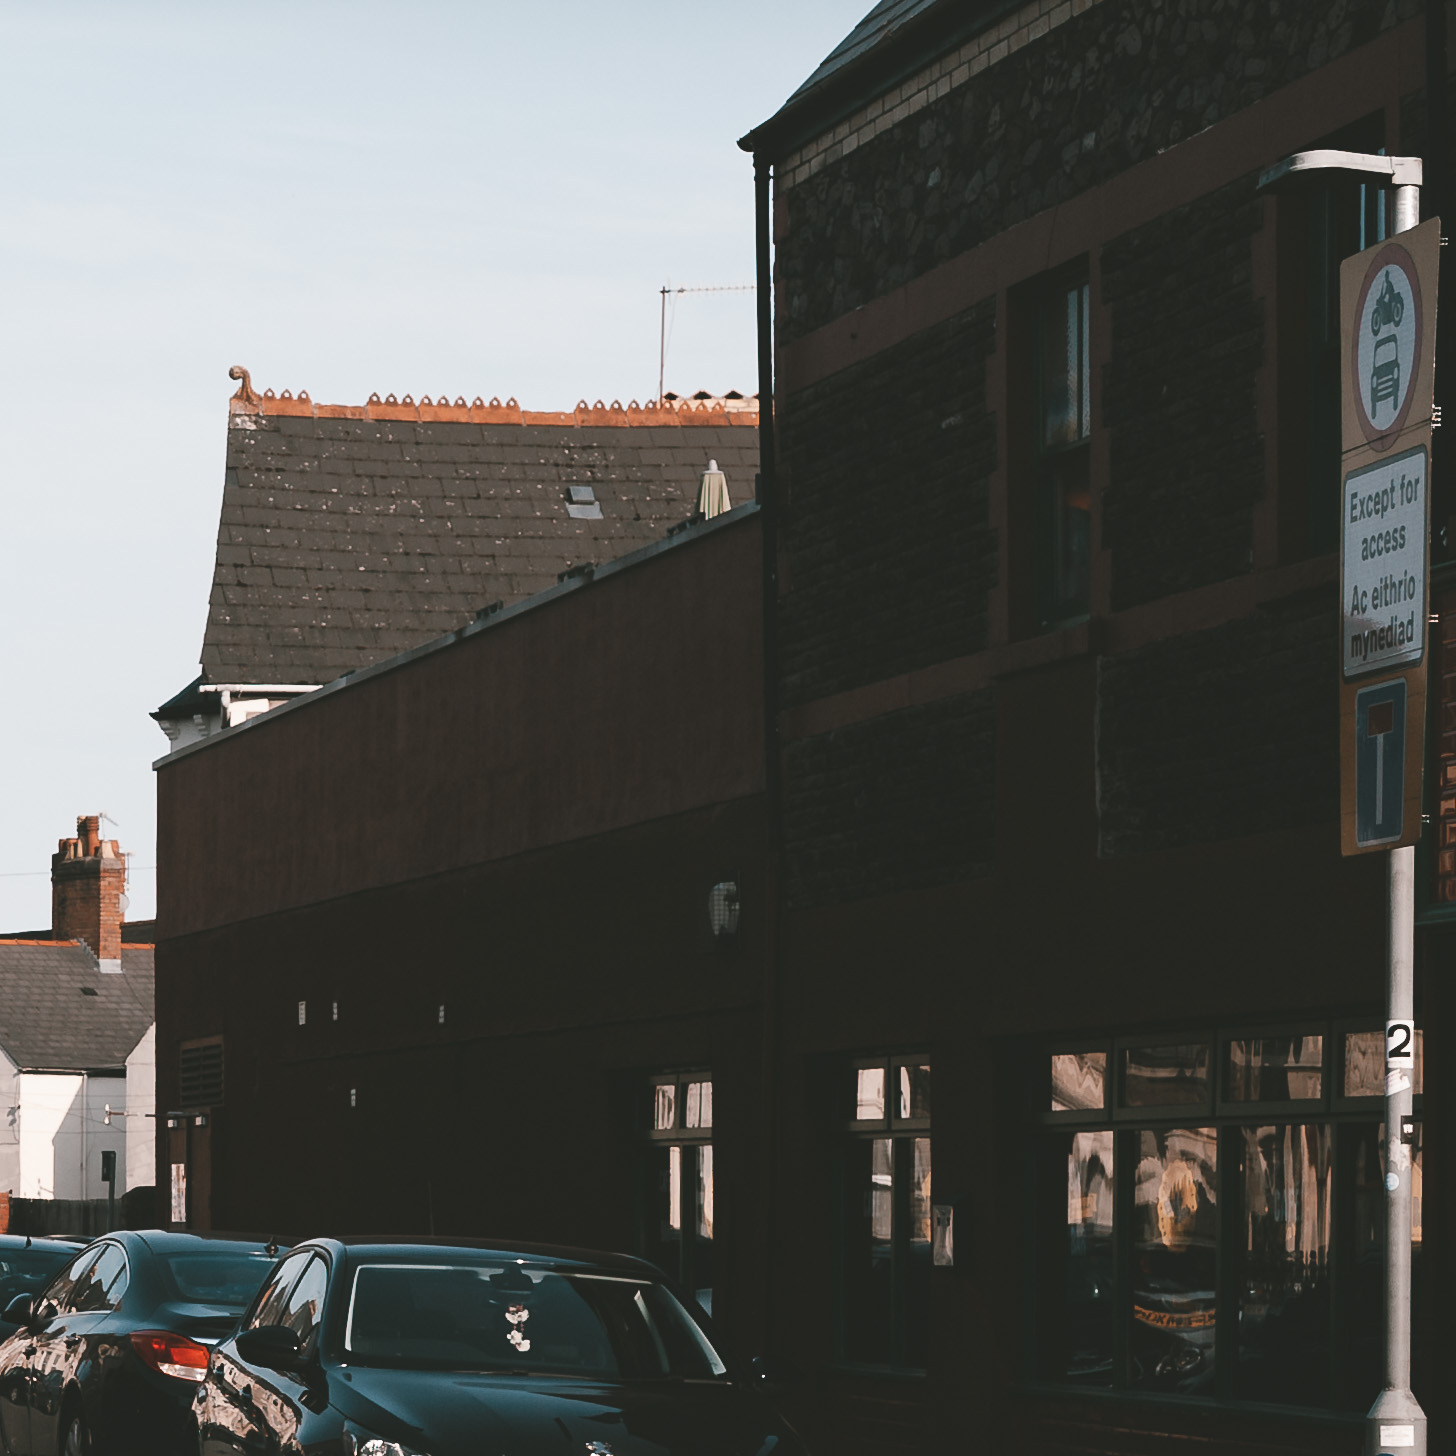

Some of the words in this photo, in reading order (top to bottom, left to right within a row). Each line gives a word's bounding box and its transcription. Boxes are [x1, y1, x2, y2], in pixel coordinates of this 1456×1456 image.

[1350, 478, 1396, 524] Except
[1399, 474, 1420, 507] for
[1361, 524, 1406, 562] access
[1350, 584, 1368, 617] Ac
[1371, 568, 1416, 611] eithrio
[1350, 610, 1415, 662] mynediad
[1387, 1023, 1411, 1059] 2
